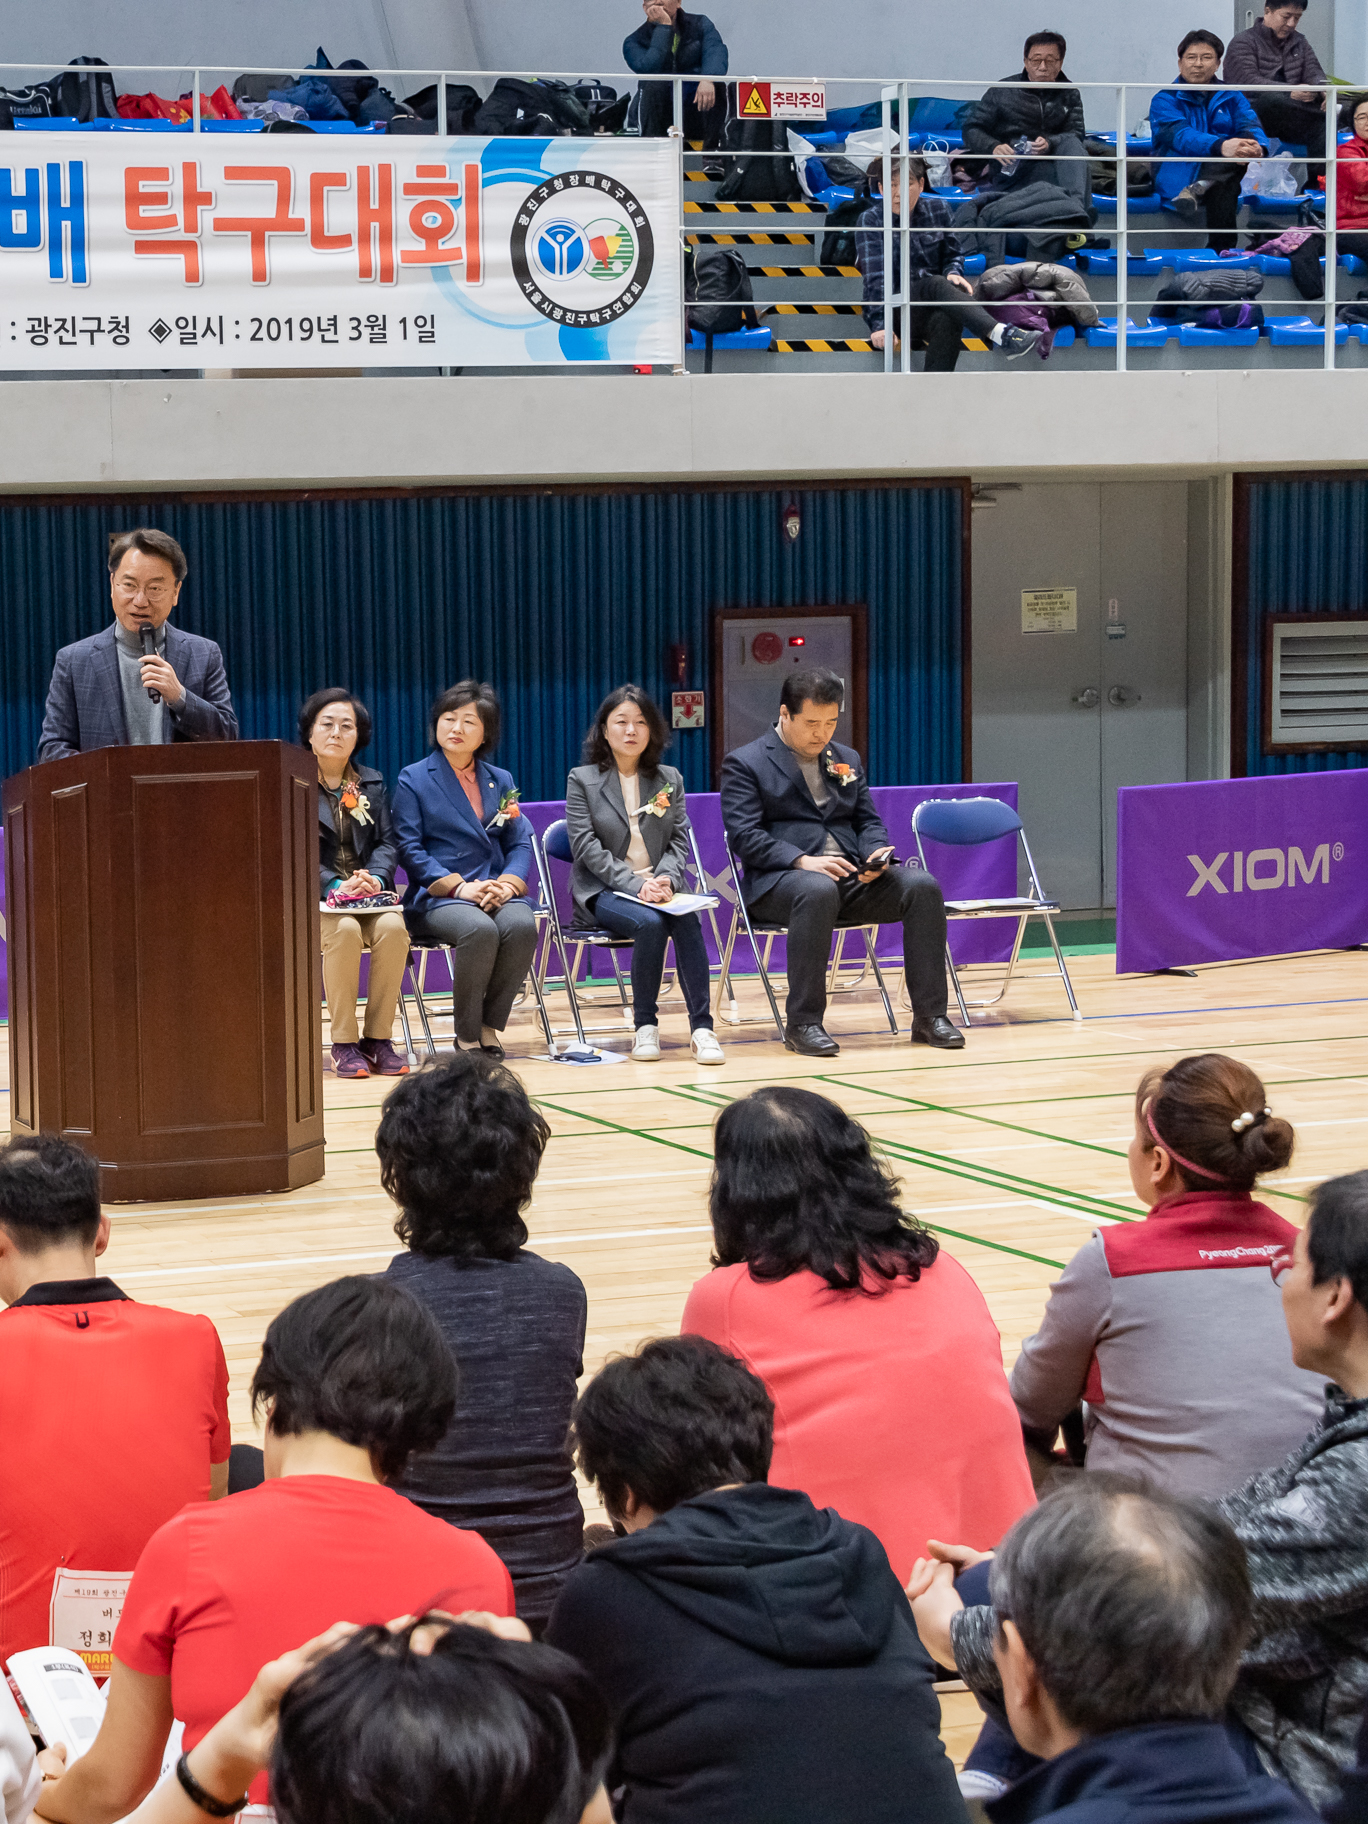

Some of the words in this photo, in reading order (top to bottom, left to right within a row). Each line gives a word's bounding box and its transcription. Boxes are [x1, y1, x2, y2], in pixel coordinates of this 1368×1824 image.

[772, 91, 824, 109] 추락주의
[518, 174, 646, 227] 광진구청장배탁구대회
[123, 160, 482, 285] 탁구대회
[523, 281, 643, 325] 서울시광진구탁구연합회
[25, 315, 131, 346] 광진구청
[174, 315, 224, 345] 일시
[249, 315, 340, 344] 2019년
[348, 314, 388, 344] 3월
[399, 314, 437, 344] 1일
[74, 1588, 99, 1596] 제19회
